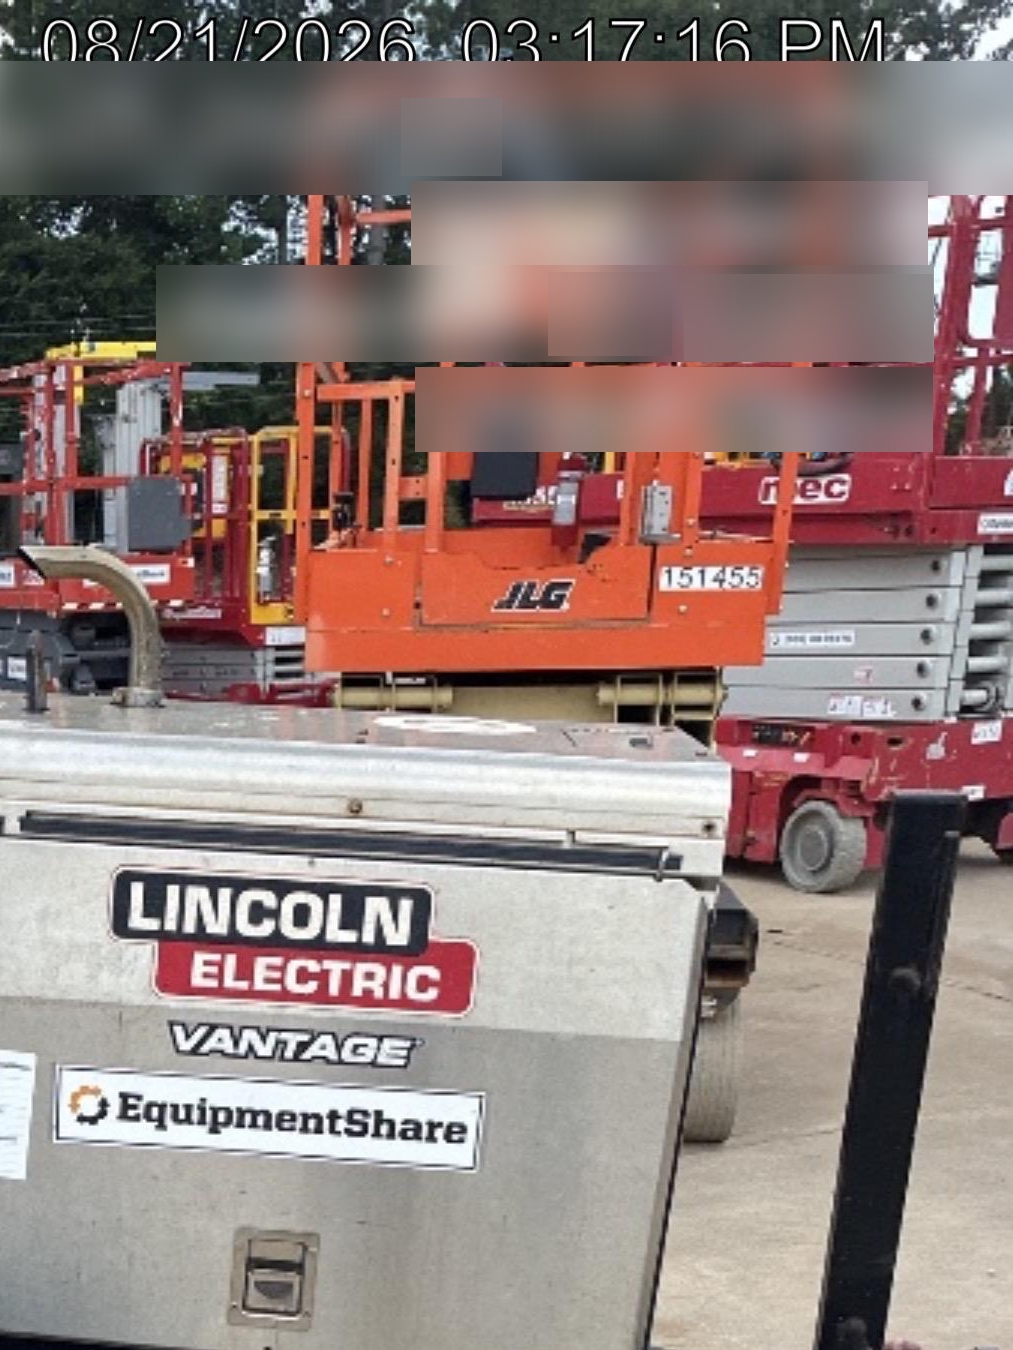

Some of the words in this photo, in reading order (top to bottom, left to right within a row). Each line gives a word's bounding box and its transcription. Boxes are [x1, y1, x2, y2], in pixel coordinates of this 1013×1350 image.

[494, 582, 572, 609] JLG
[662, 567, 761, 588] 151455
[127, 881, 413, 946] LINCOLN
[190, 950, 441, 1001] ELECTRIC
[169, 1020, 416, 1068] VANTAGE
[117, 1091, 468, 1144] EquipmentShare
